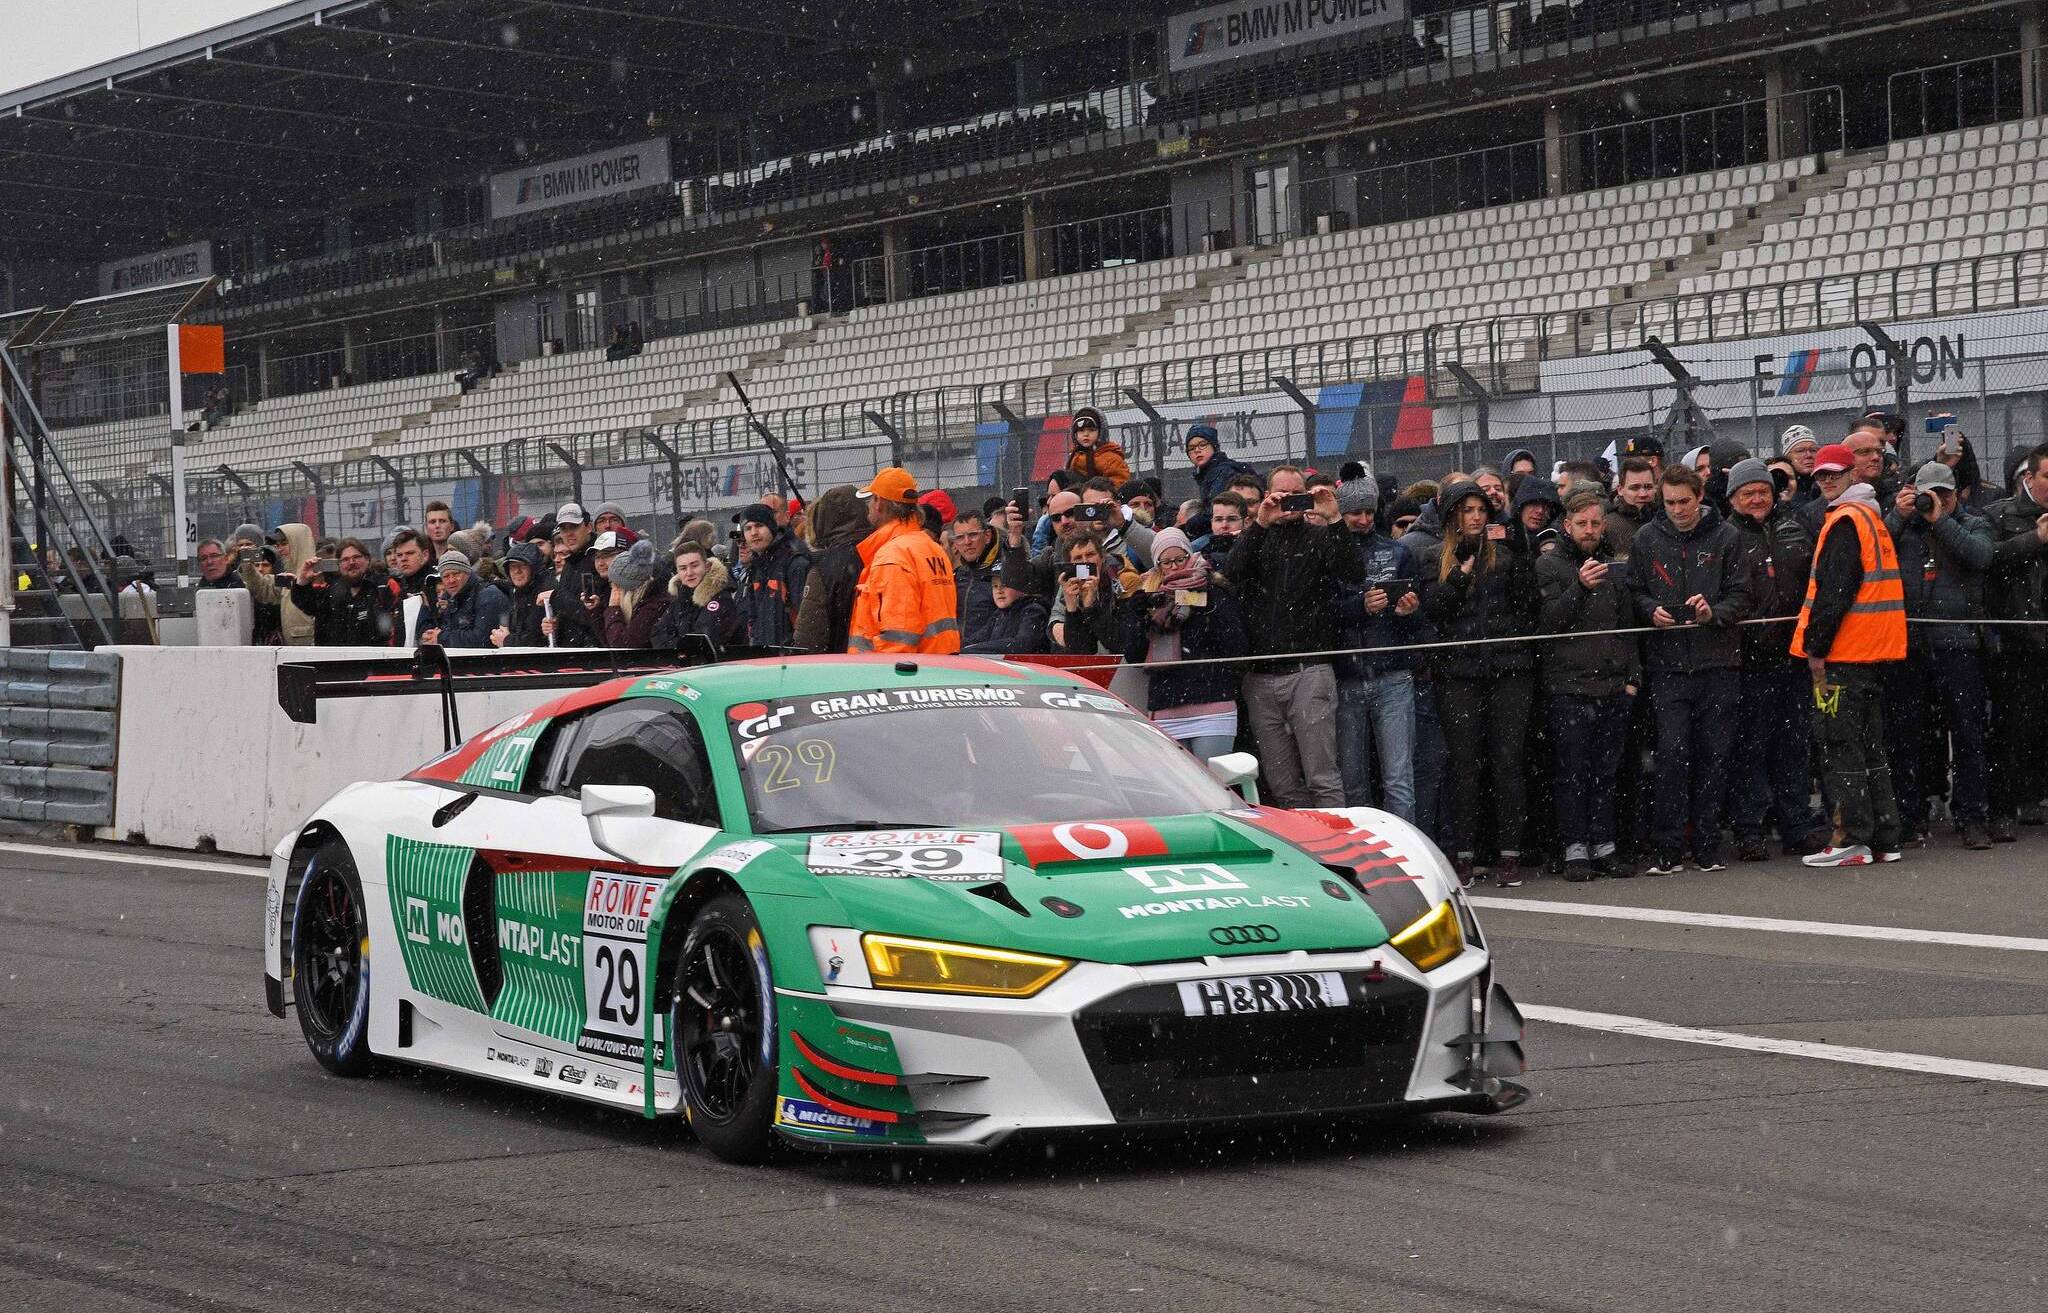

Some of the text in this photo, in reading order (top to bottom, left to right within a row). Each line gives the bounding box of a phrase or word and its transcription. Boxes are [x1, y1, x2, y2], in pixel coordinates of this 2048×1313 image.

[1227, 5, 1280, 47] BMW
[1284, 0, 1304, 34] M
[543, 154, 641, 199] BMW M POWER
[129, 262, 155, 287] BMW
[810, 692, 889, 716] GRAN
[892, 688, 1016, 703] TURISMO
[817, 699, 1024, 722] THE REAL DRIVING SIMULATOR
[755, 738, 836, 794] 29
[851, 847, 964, 872] 29
[588, 879, 657, 918] ROWE
[1117, 896, 1312, 920] MONTAPLAST
[586, 912, 646, 934] MOTOR OIL
[595, 944, 641, 1027] 29
[797, 1110, 873, 1129] MICHELIN
